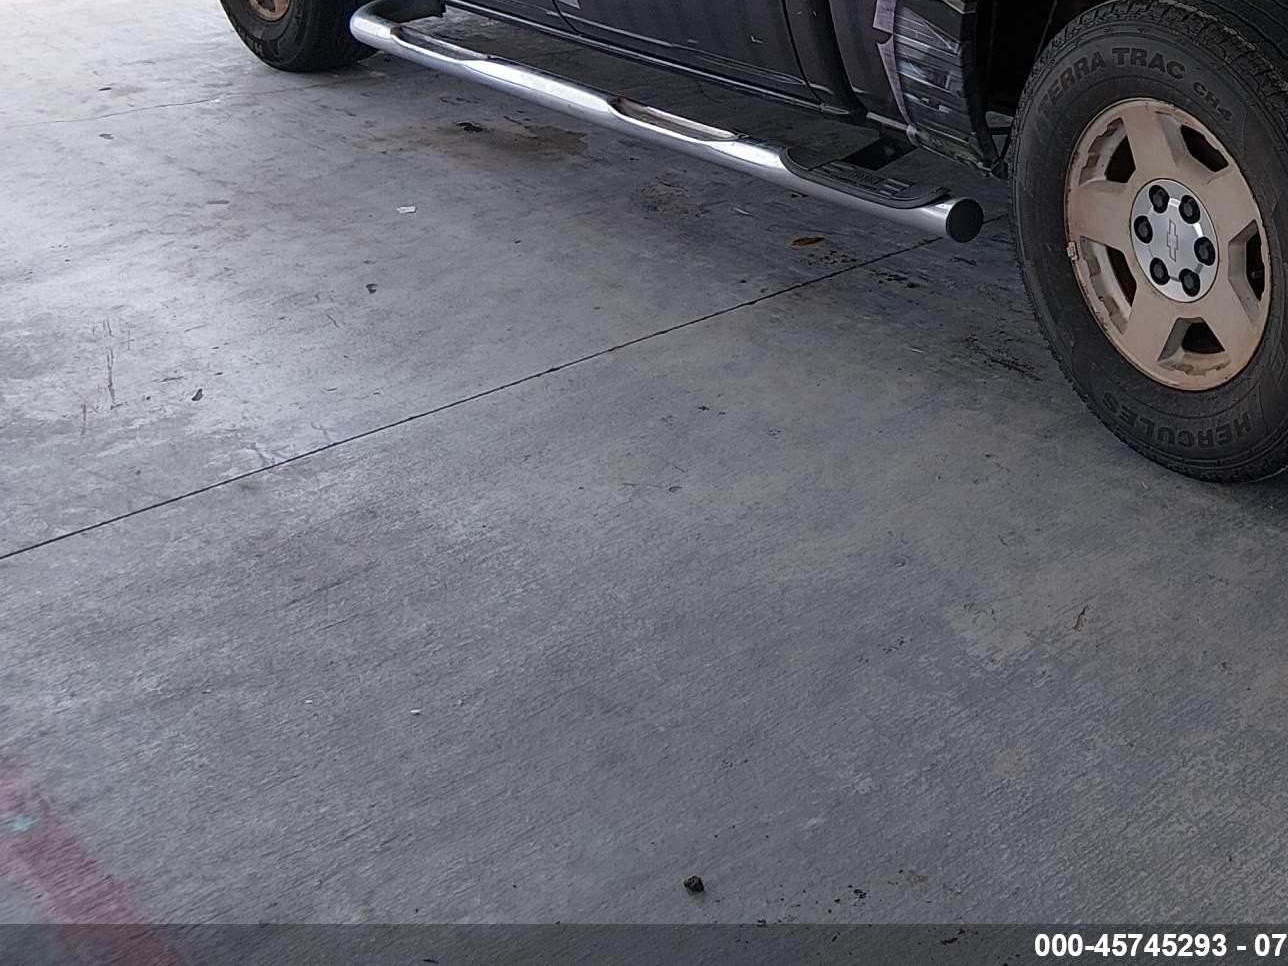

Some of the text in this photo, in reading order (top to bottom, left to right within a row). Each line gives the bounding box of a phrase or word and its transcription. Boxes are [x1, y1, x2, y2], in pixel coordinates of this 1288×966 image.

[1036, 50, 1106, 116] TERRA
[1111, 47, 1187, 80] TRAC
[1101, 392, 1254, 449] HERCULES
